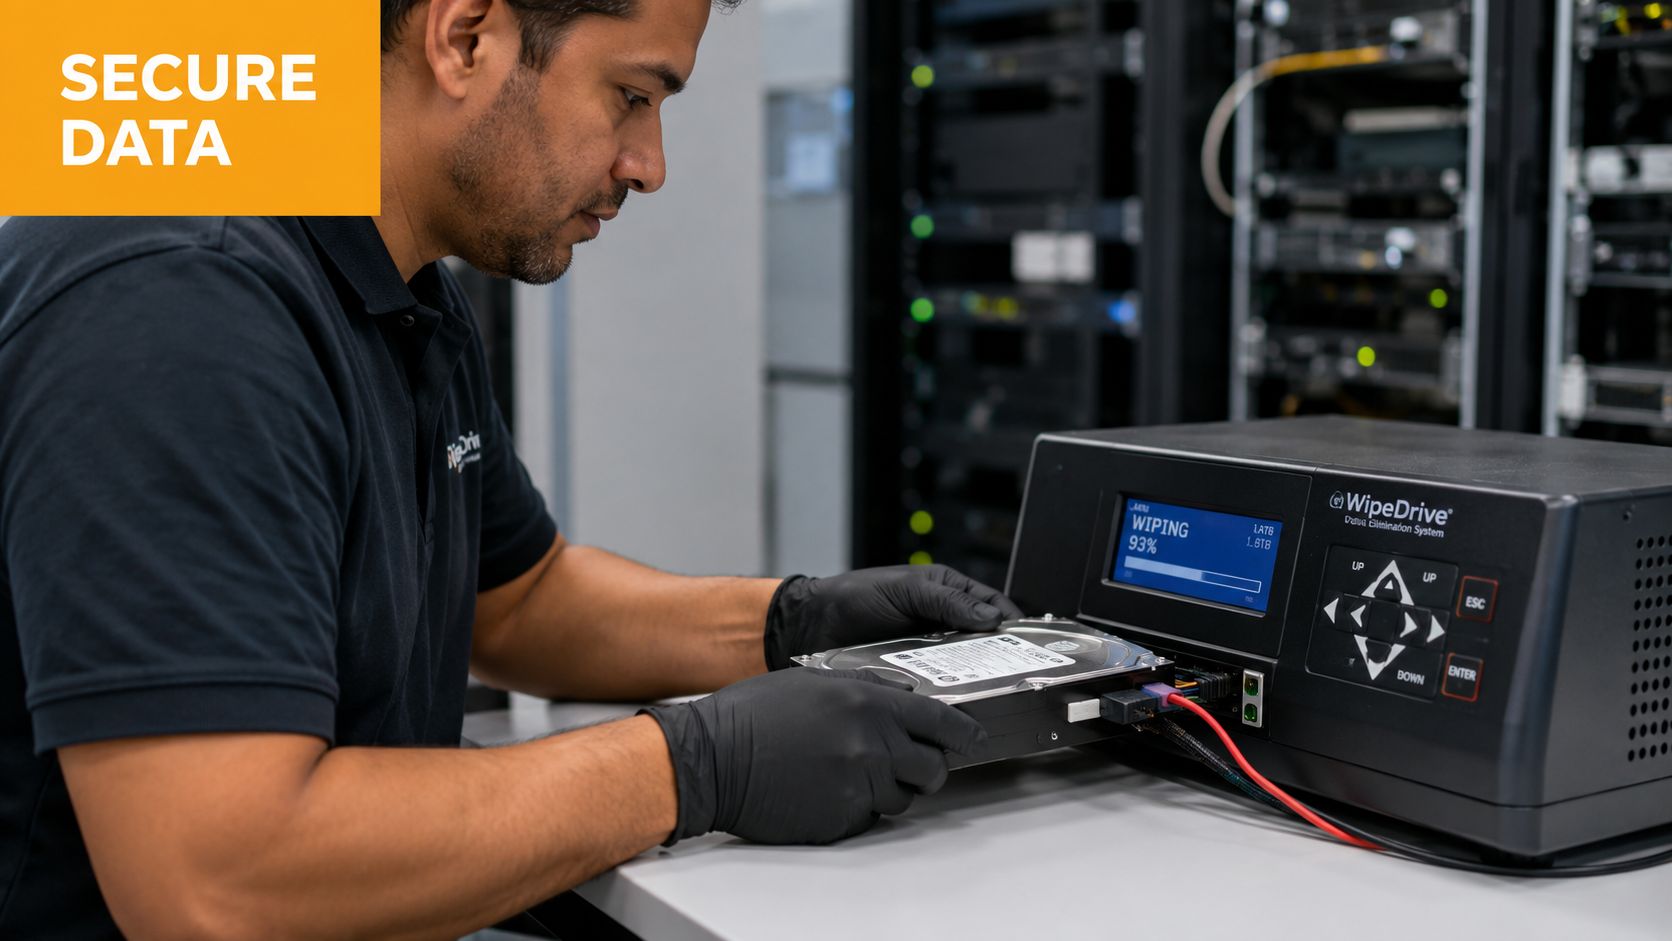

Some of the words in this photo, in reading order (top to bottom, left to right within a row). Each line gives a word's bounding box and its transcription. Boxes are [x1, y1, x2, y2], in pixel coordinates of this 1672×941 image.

[1132, 514, 1189, 538] WIPING
[1414, 525, 1445, 538] System
[1128, 535, 1157, 554] 93%
[1352, 561, 1365, 571] UP
[1422, 572, 1437, 583] UP
[1465, 596, 1486, 610] ESC
[1397, 670, 1425, 686] DOWN
[1448, 665, 1477, 682] ENTER
